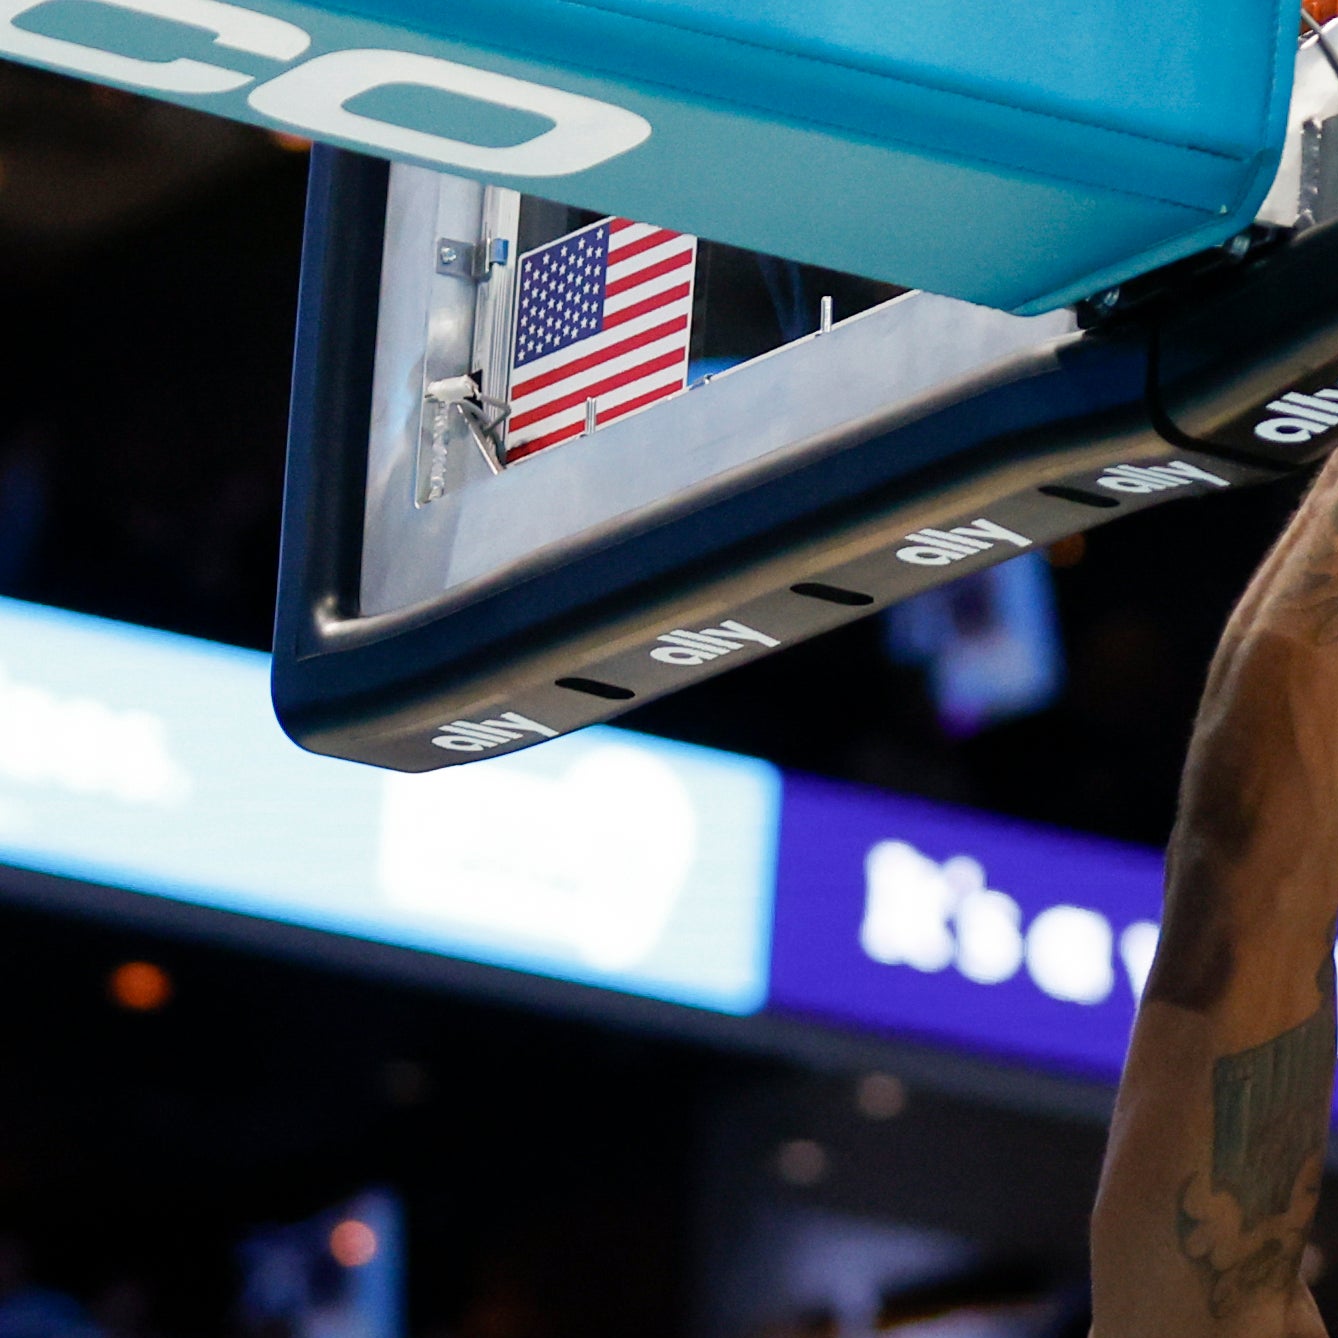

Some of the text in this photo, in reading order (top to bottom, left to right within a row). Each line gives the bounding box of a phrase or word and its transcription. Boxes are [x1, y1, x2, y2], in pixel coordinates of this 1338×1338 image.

[1095, 458, 1231, 496] ally
[895, 517, 1033, 567] ally
[649, 618, 781, 667] ally
[431, 710, 559, 753] ally
